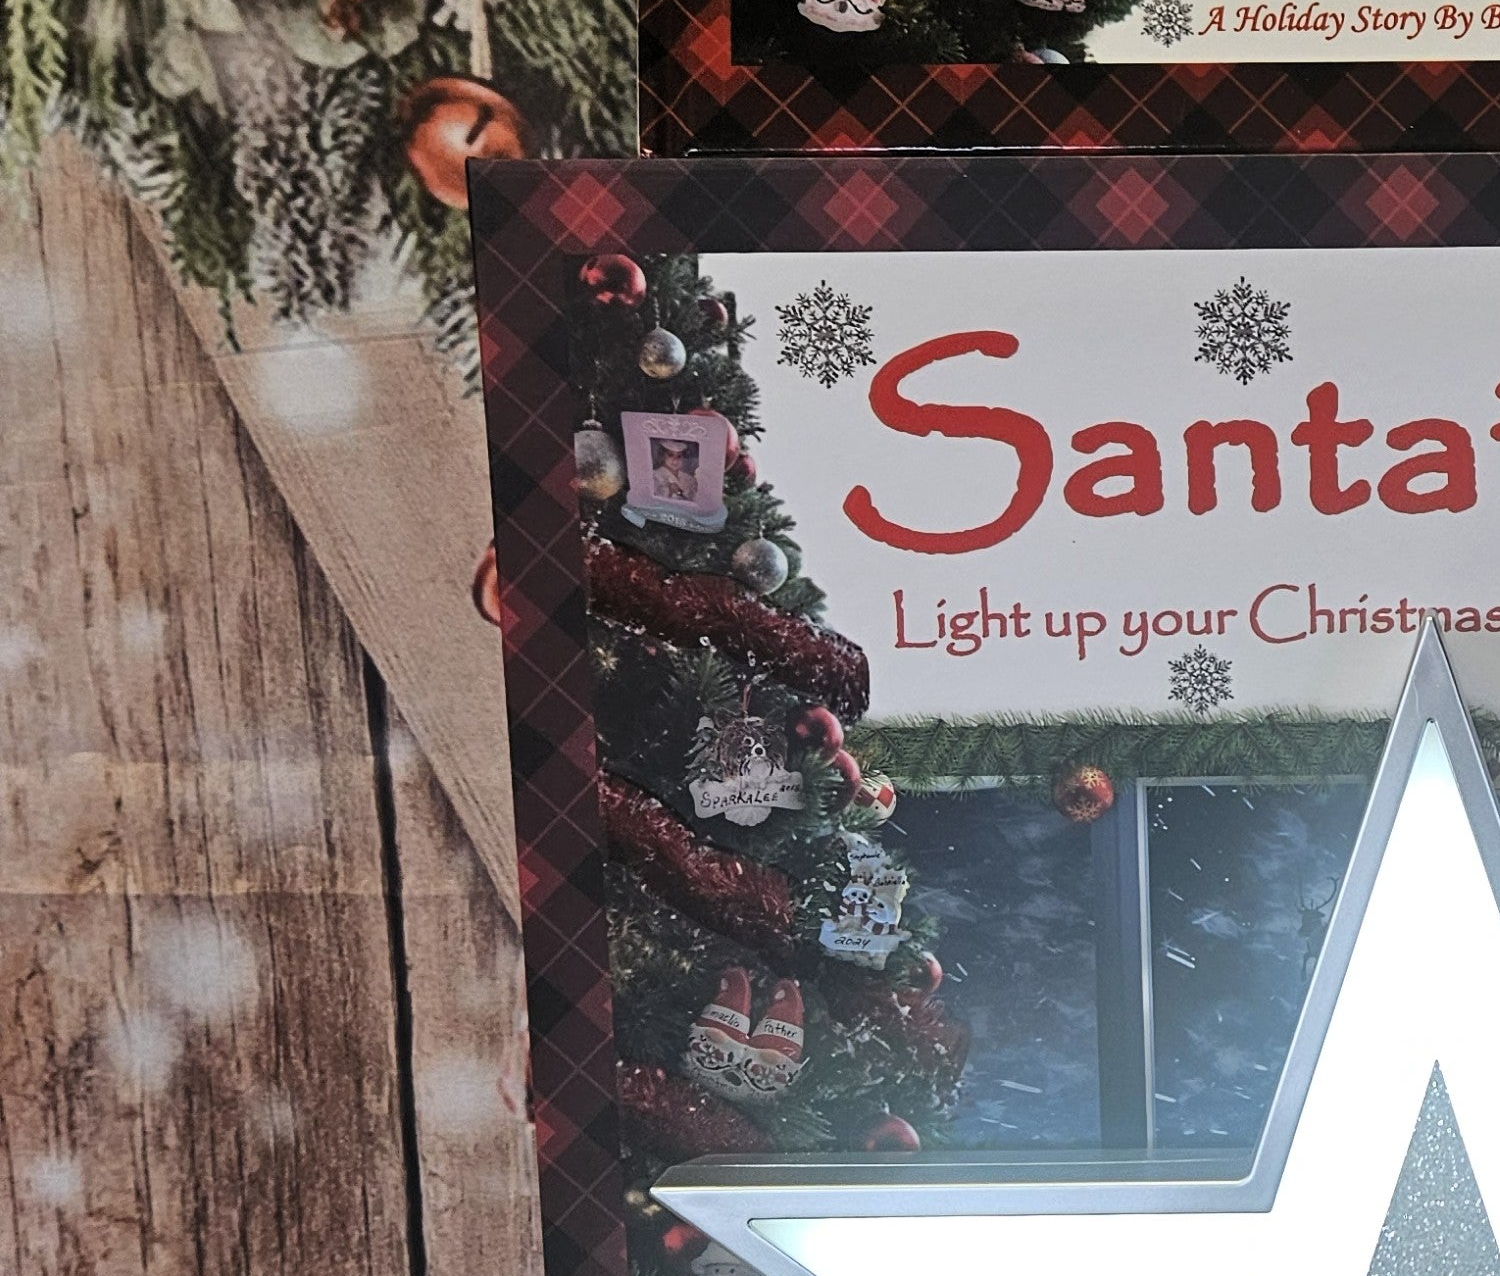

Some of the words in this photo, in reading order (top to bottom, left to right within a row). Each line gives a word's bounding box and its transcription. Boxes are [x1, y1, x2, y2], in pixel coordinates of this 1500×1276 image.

[1198, 5, 1227, 36] A
[1234, 1, 1345, 40] Holiday
[1350, 4, 1427, 41] Story
[1433, 3, 1474, 40] By
[892, 586, 1031, 657] Light
[1044, 609, 1107, 660] up
[1119, 609, 1239, 657] your
[834, 936, 871, 949] 2024
